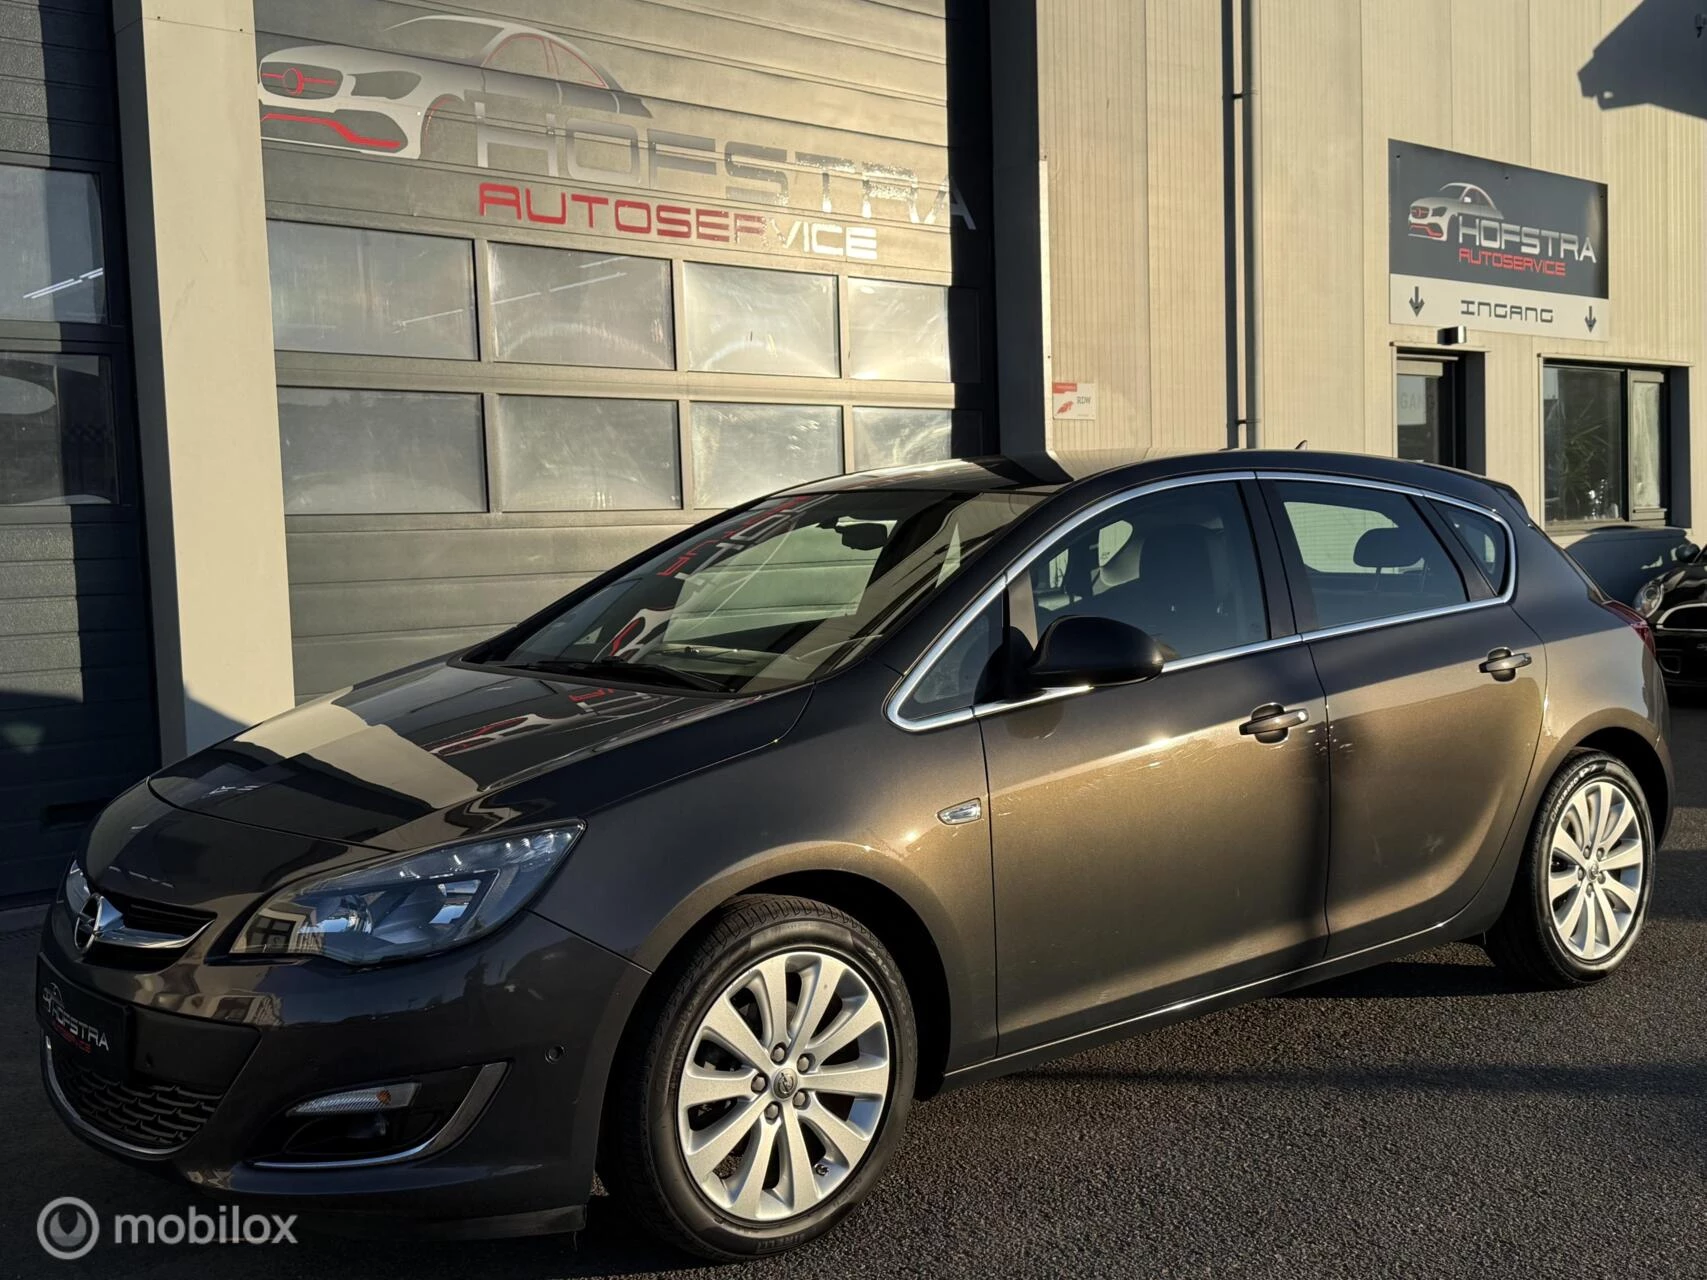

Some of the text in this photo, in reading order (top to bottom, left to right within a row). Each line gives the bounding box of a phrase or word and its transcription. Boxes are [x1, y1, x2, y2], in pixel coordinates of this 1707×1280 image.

[475, 98, 977, 231] HOFSTRA
[478, 182, 878, 260] AUTOSERVICE
[1459, 214, 1597, 264] HOFSTRA
[1459, 248, 1566, 276] AUTOSERVICE
[1460, 300, 1554, 323] INGANG
